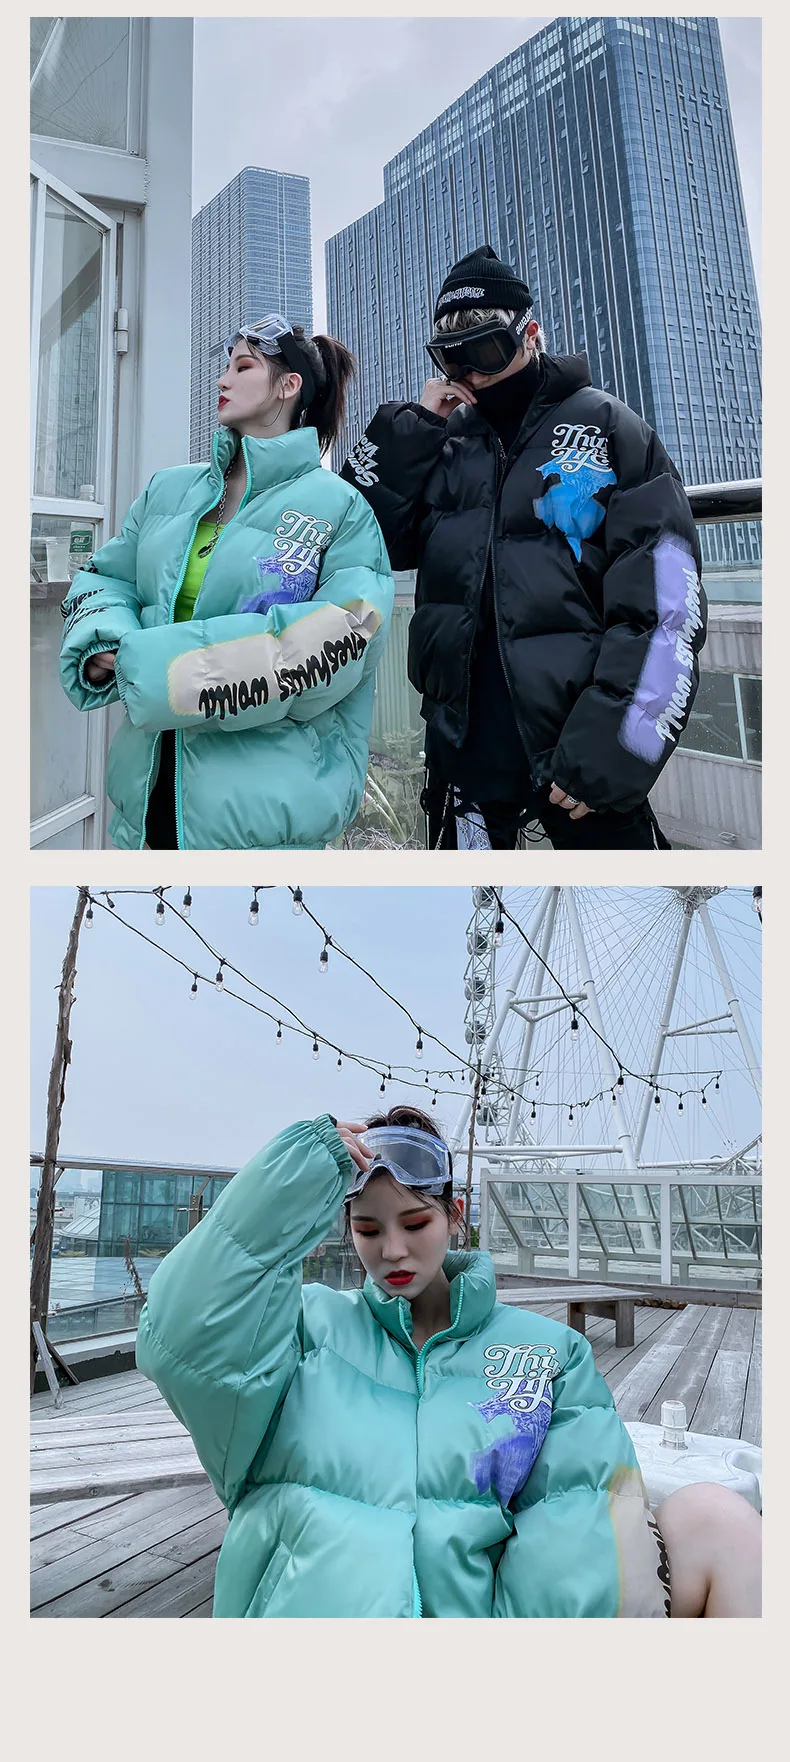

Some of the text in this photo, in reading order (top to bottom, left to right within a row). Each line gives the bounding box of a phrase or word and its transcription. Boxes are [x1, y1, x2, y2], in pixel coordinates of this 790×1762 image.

[276, 509, 333, 547] Thu
[273, 538, 320, 576] Lif
[483, 1343, 562, 1377] Thu
